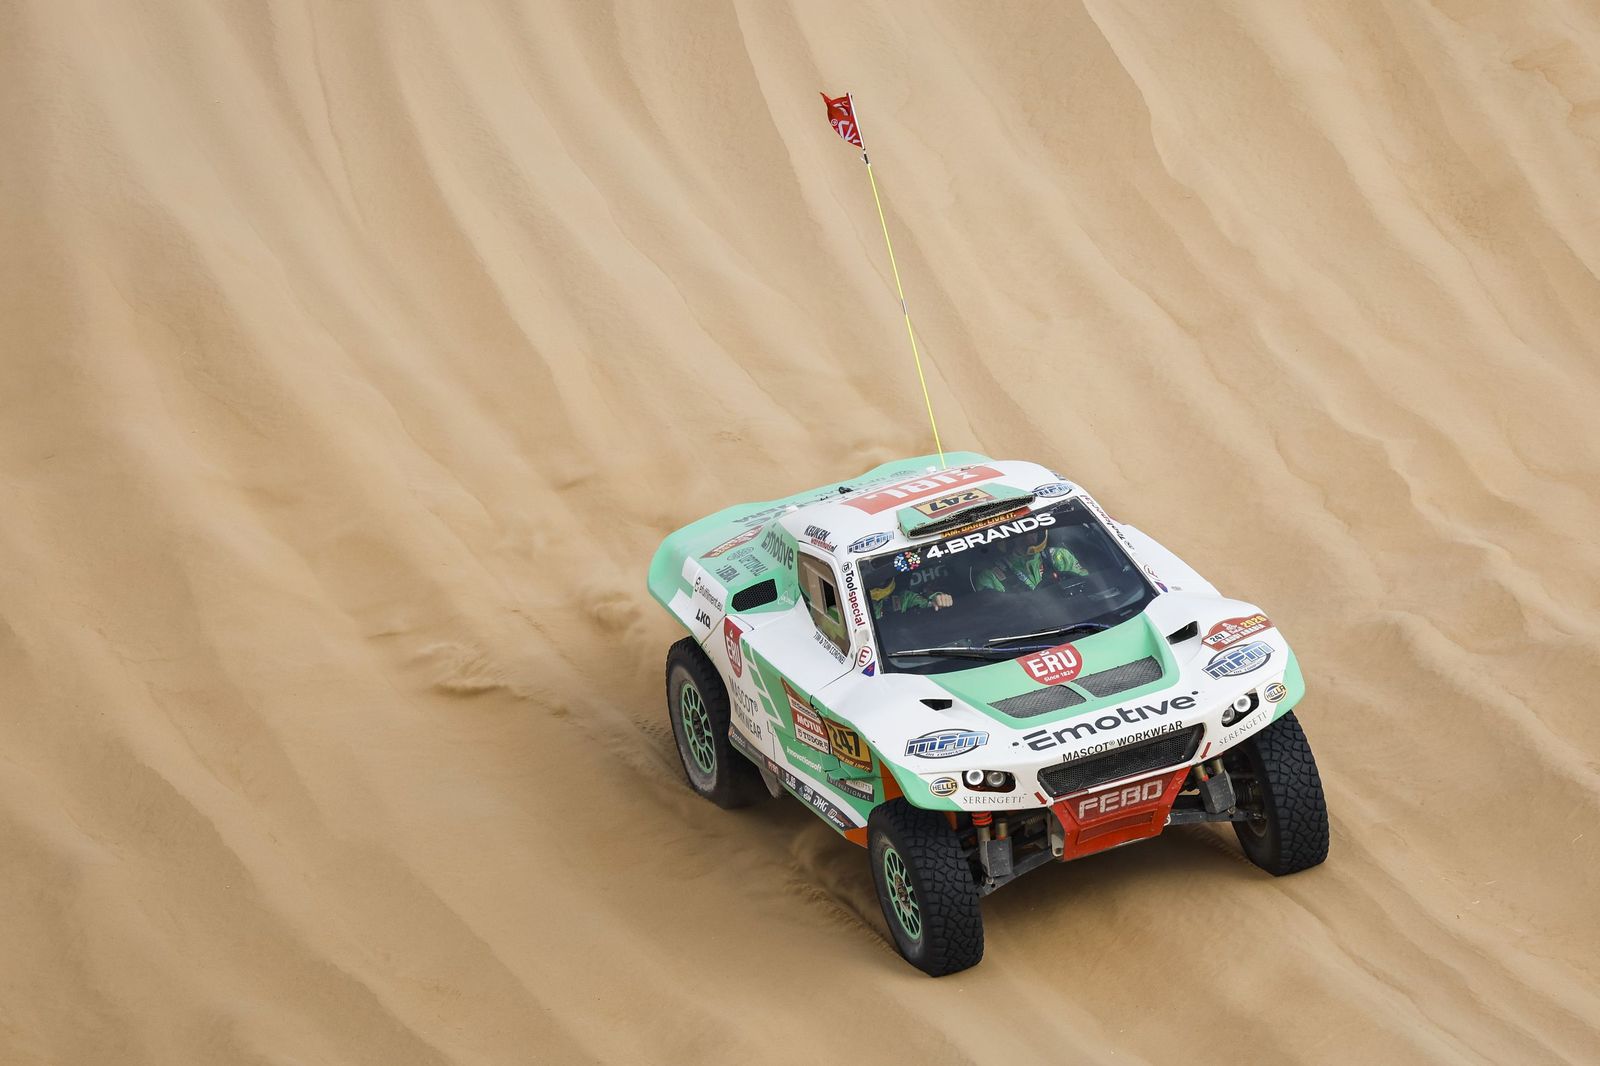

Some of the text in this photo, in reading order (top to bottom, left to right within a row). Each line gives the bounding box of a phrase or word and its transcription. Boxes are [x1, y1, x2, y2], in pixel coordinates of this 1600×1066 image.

[929, 492, 979, 512] 247
[804, 525, 831, 541] KEUKEN
[926, 512, 1057, 559] 4.BRANDS
[846, 570, 866, 627] Toolspecial
[695, 608, 711, 630] LKQ
[1240, 616, 1267, 628] 2026
[1210, 633, 1225, 643] 247
[859, 649, 869, 663] E
[1026, 648, 1078, 679] ERU
[1060, 668, 1075, 679] 1824
[1266, 684, 1286, 699] HELLA
[797, 714, 823, 735] MOTUL
[1219, 711, 1267, 745] SERENGETI
[803, 731, 823, 748] TUDOR
[827, 722, 861, 758] 247
[1116, 721, 1184, 747] WORKWEAR
[930, 781, 958, 793] HELLA
[813, 795, 829, 812] DHG
[963, 796, 1023, 805] SERENGETI
[1079, 780, 1163, 819] FEBO
